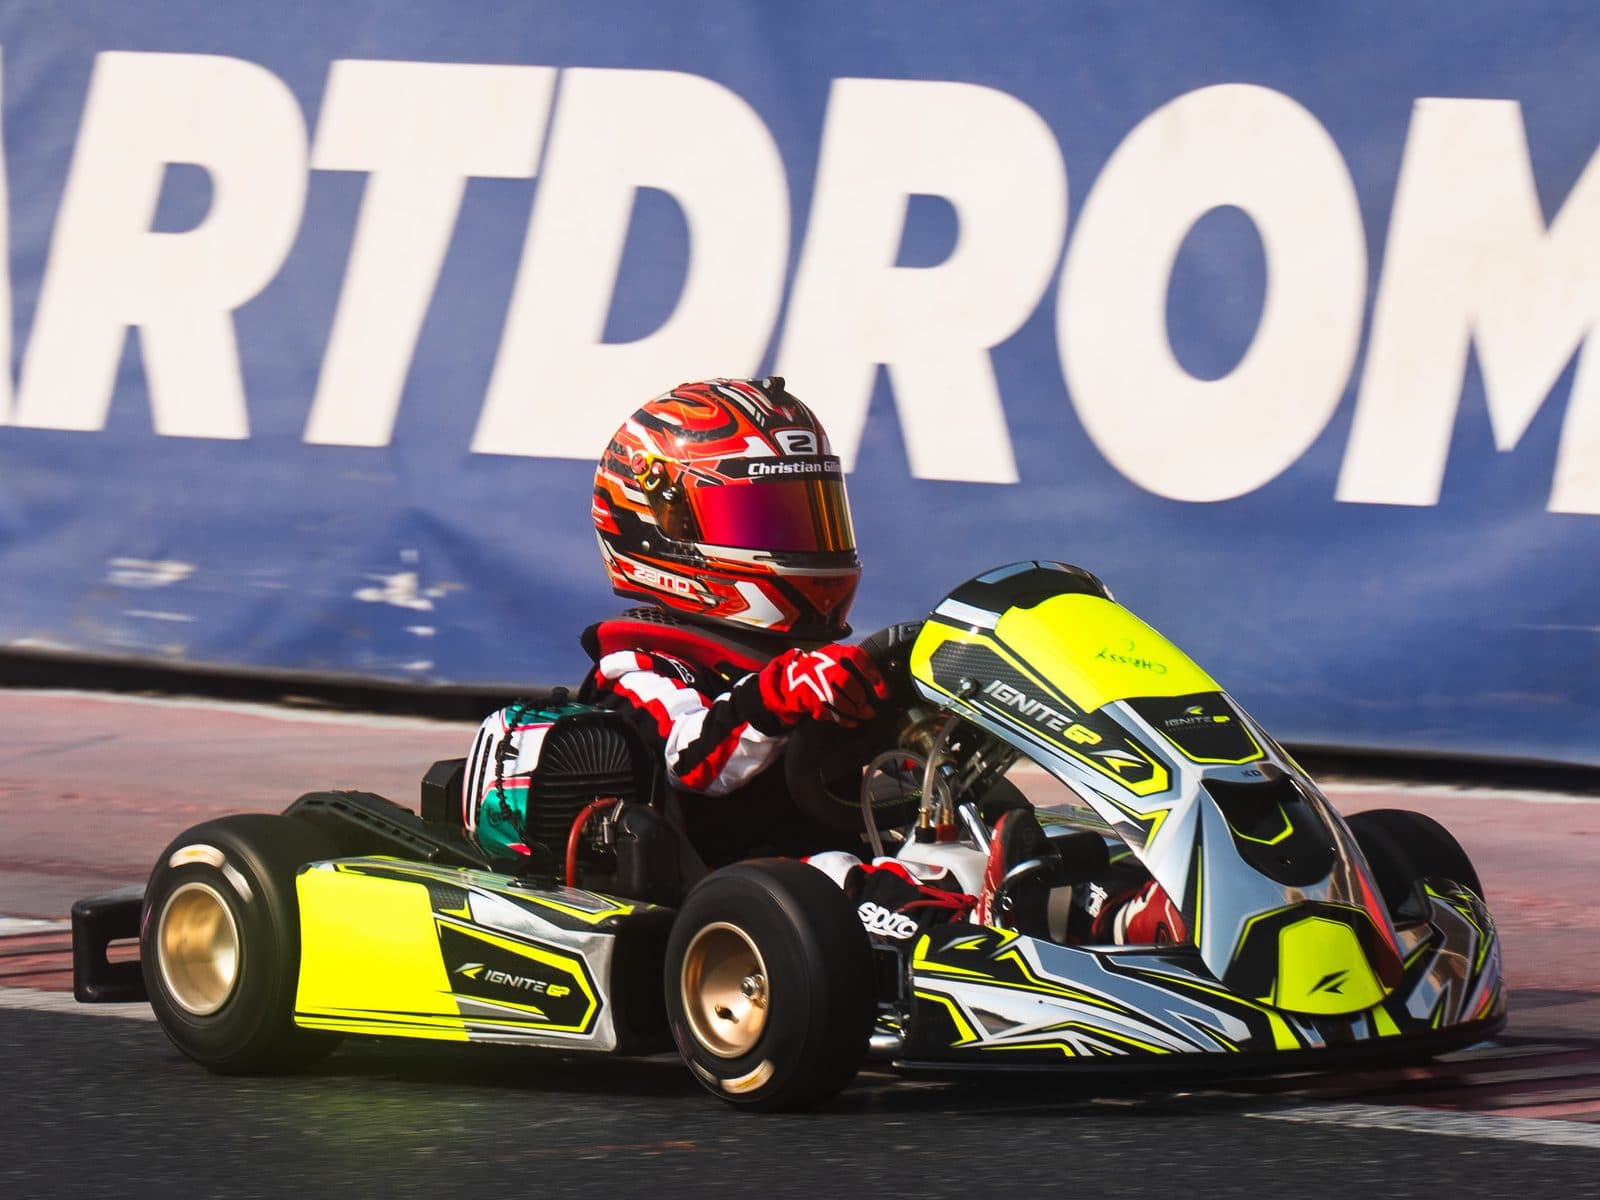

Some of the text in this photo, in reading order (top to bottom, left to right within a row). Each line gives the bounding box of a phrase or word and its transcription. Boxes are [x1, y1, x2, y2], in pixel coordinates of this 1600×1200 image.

[0, 48, 1600, 514] RTDROM
[787, 434, 813, 452] 2
[748, 461, 821, 476] Christian
[634, 565, 690, 593] zamp
[983, 680, 1073, 732] IGNITE
[484, 969, 548, 993] IGNITE
